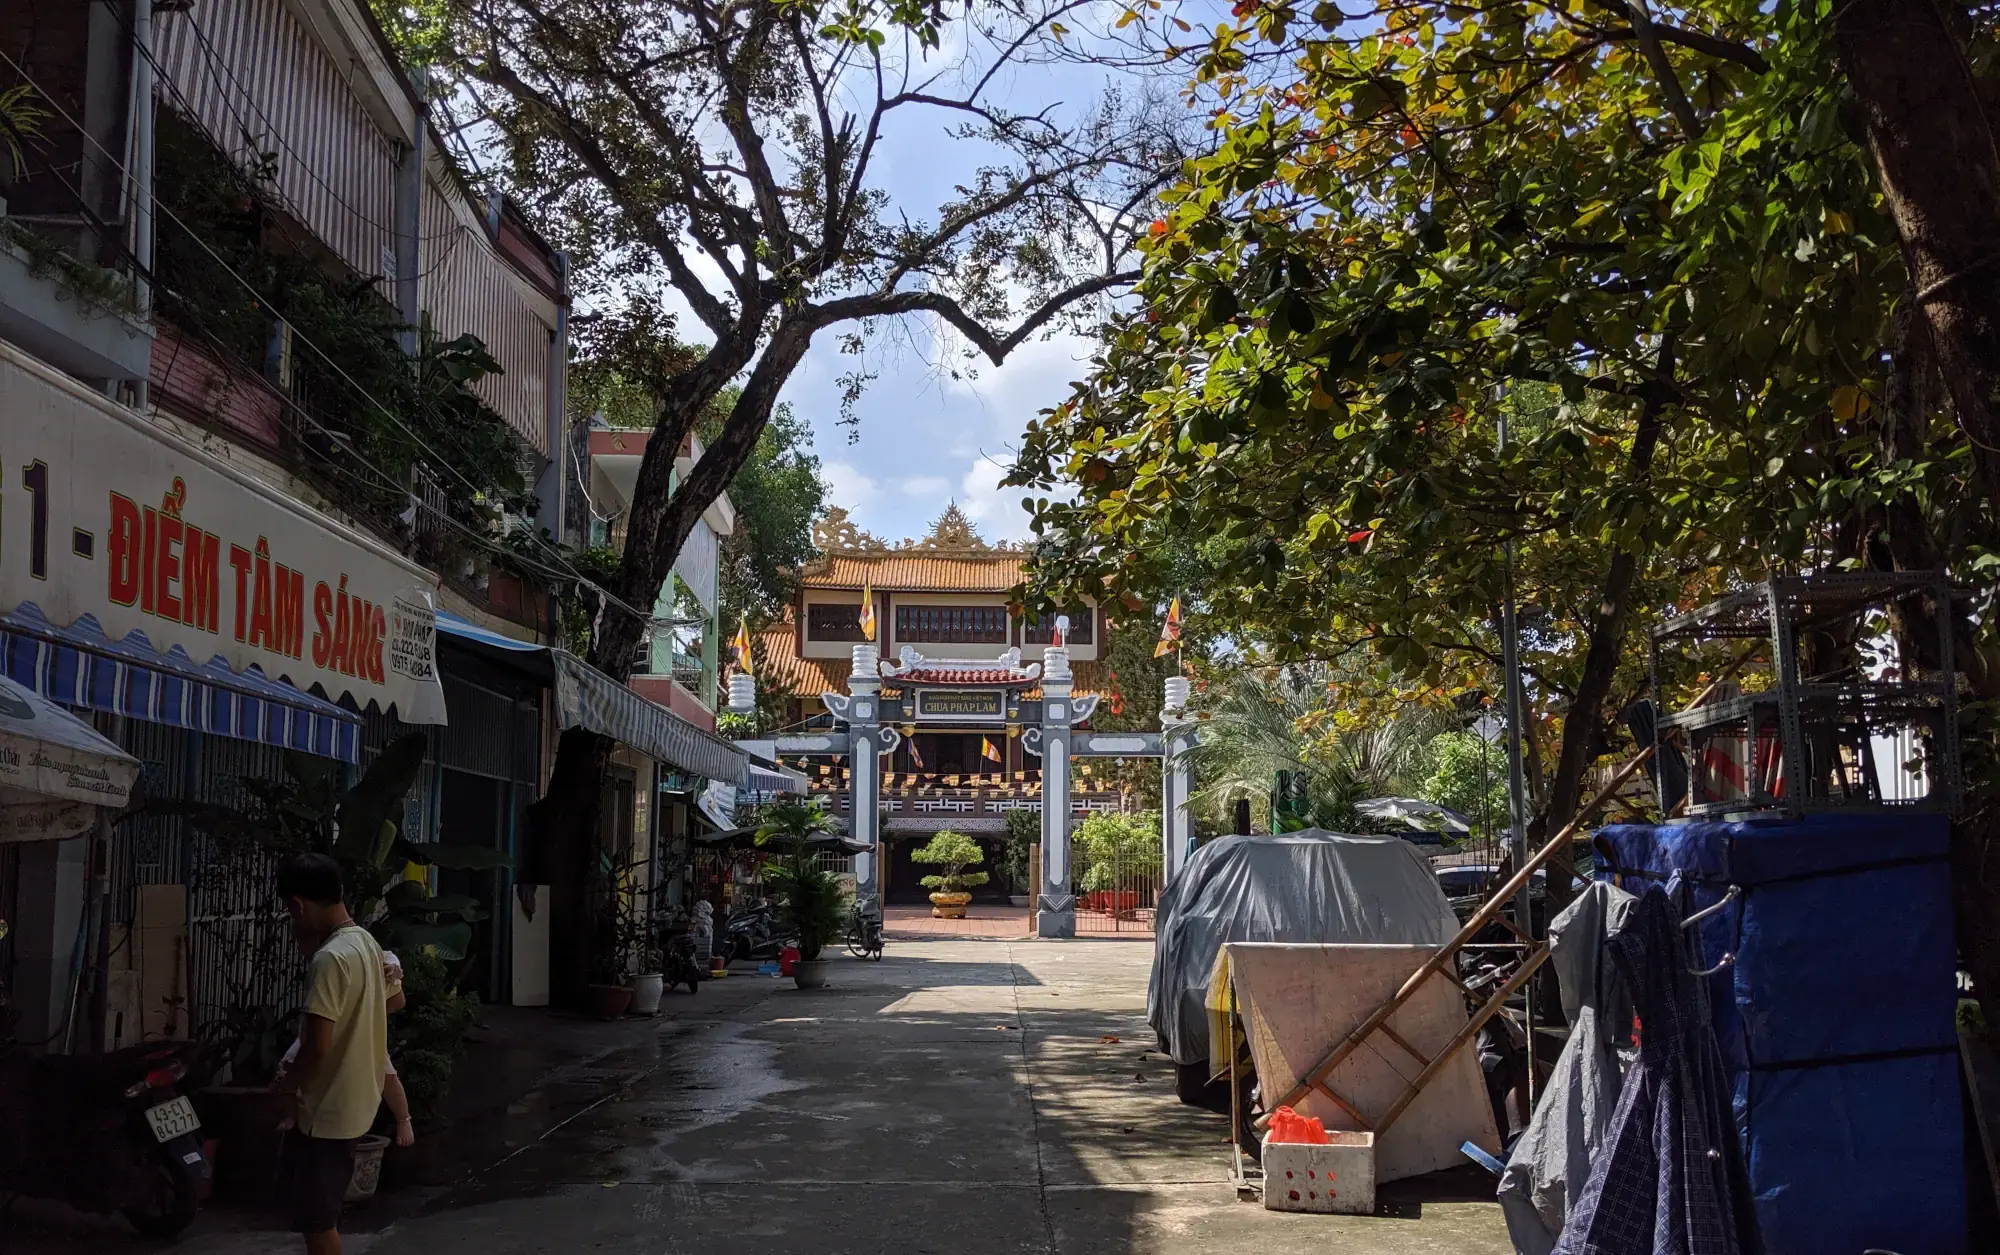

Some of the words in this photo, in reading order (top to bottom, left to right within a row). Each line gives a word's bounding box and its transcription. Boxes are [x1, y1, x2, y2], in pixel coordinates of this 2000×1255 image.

[108, 476, 220, 634] ĐIỂM
[230, 535, 304, 660] TÂM
[312, 573, 386, 685] SÁNG
